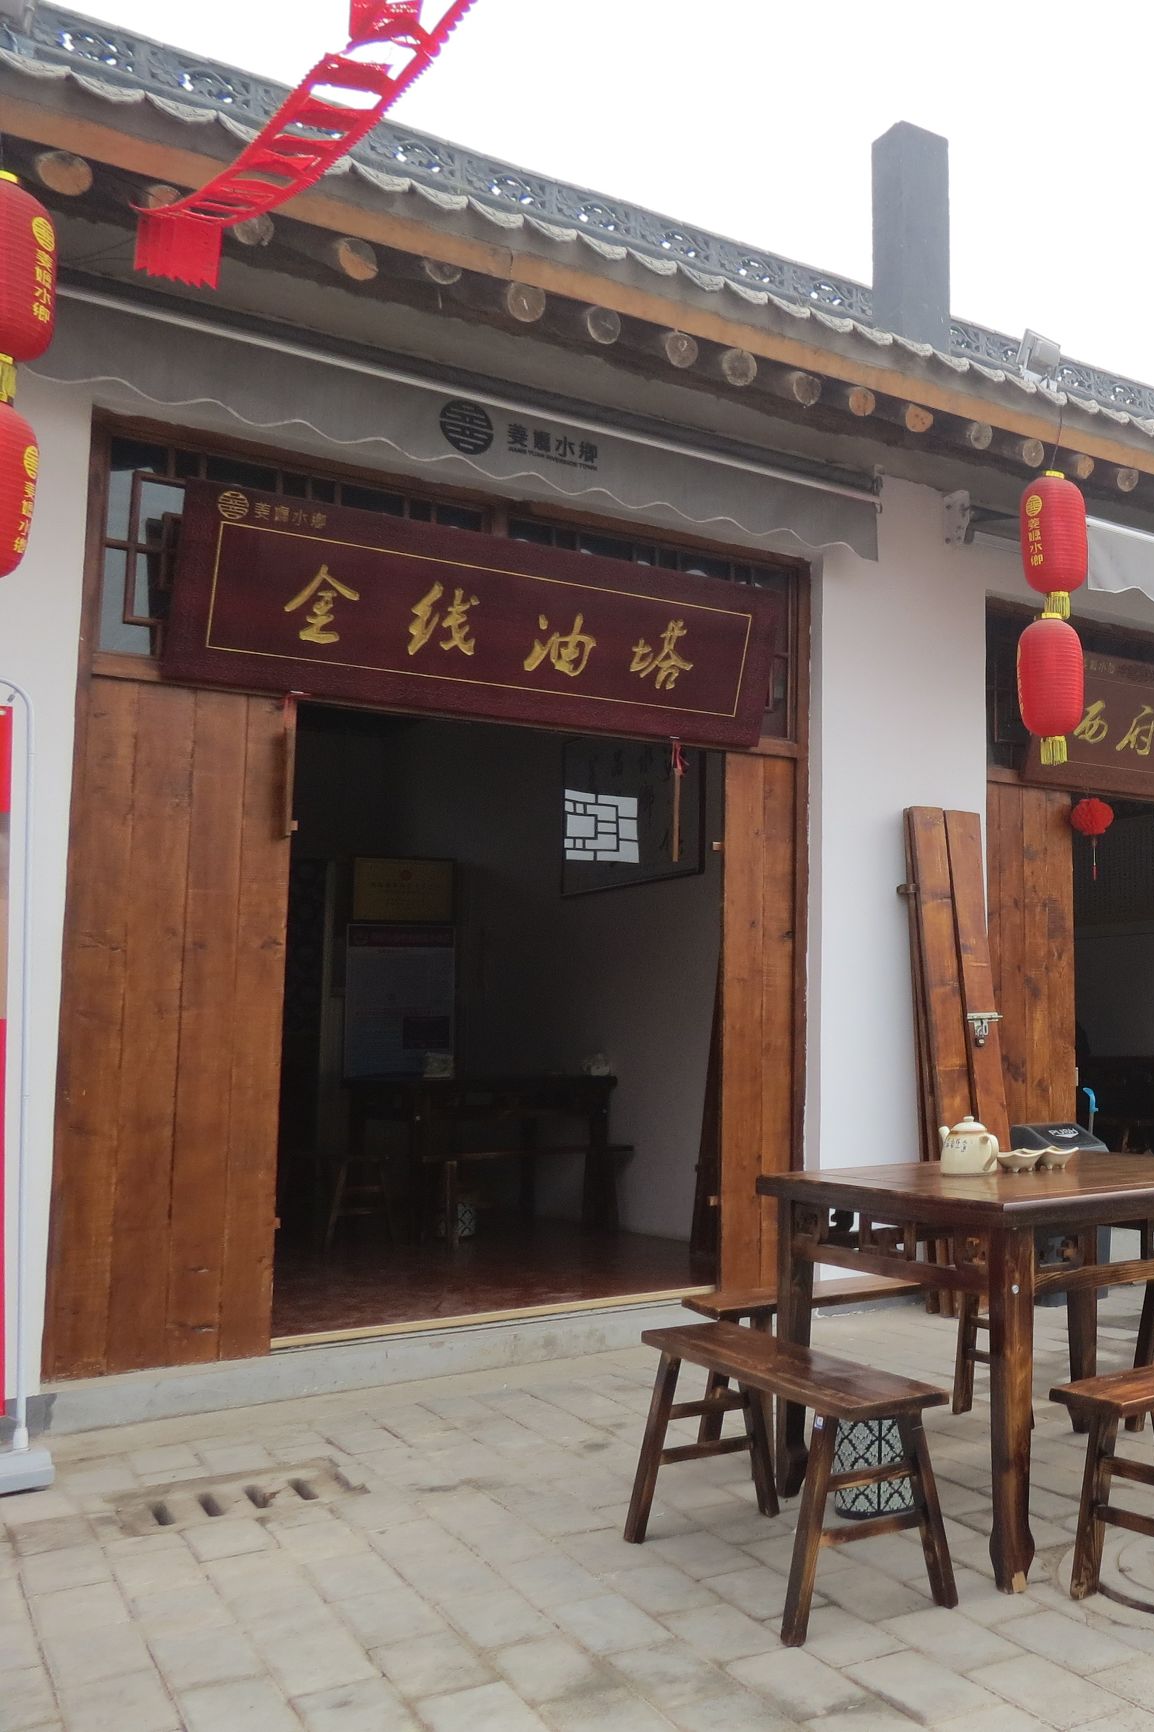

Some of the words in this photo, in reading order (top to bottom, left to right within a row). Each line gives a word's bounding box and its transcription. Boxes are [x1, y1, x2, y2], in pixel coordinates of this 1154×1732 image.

[283, 564, 694, 689] 金线油塔
[1048, 1128, 1078, 1136] PUSH
